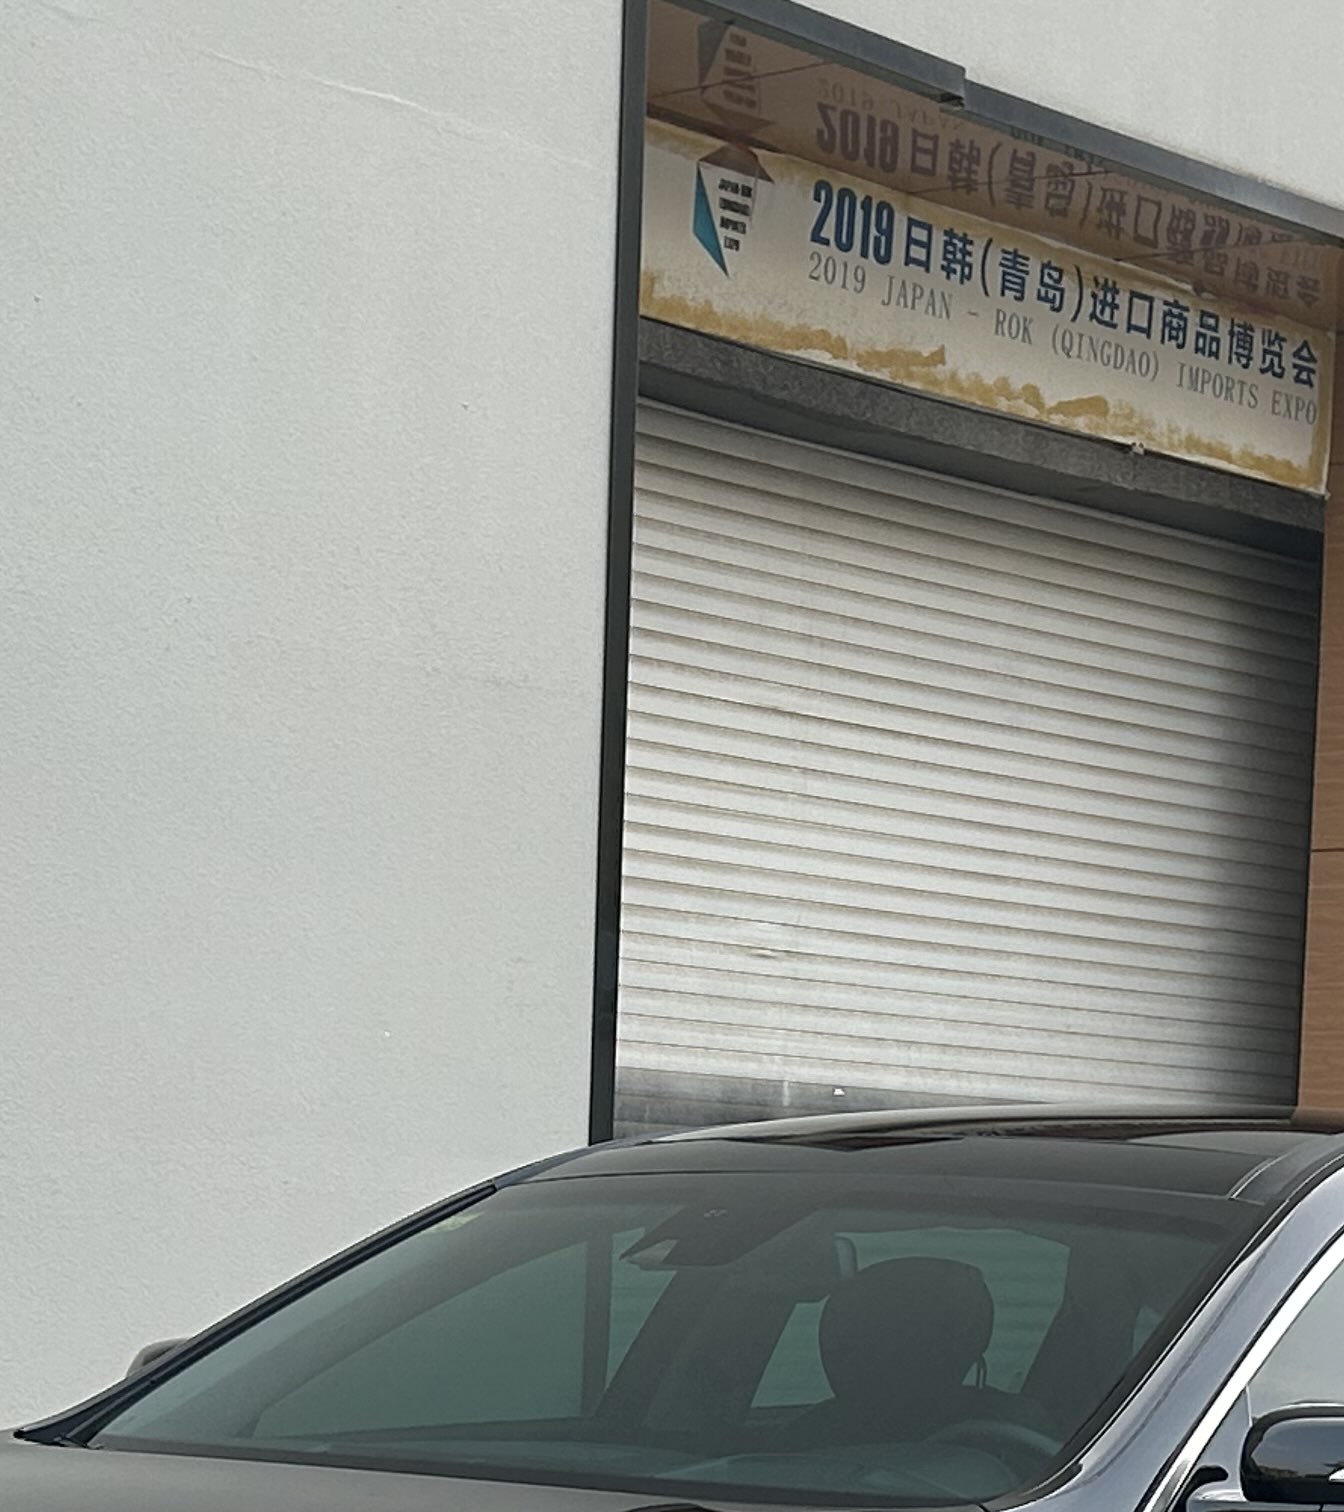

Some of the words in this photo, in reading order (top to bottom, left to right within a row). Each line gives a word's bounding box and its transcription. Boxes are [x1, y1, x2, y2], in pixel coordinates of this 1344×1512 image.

[808, 250, 867, 294] 2019
[881, 275, 952, 321] JAPAN
[994, 308, 1033, 345] ROK
[1052, 324, 1160, 383] (QINGDAO)
[1176, 362, 1259, 410] IMPORTS
[1271, 390, 1318, 426] EXPO
[810, 179, 1319, 389] 2019日韩(青岛)进口商品博览会
